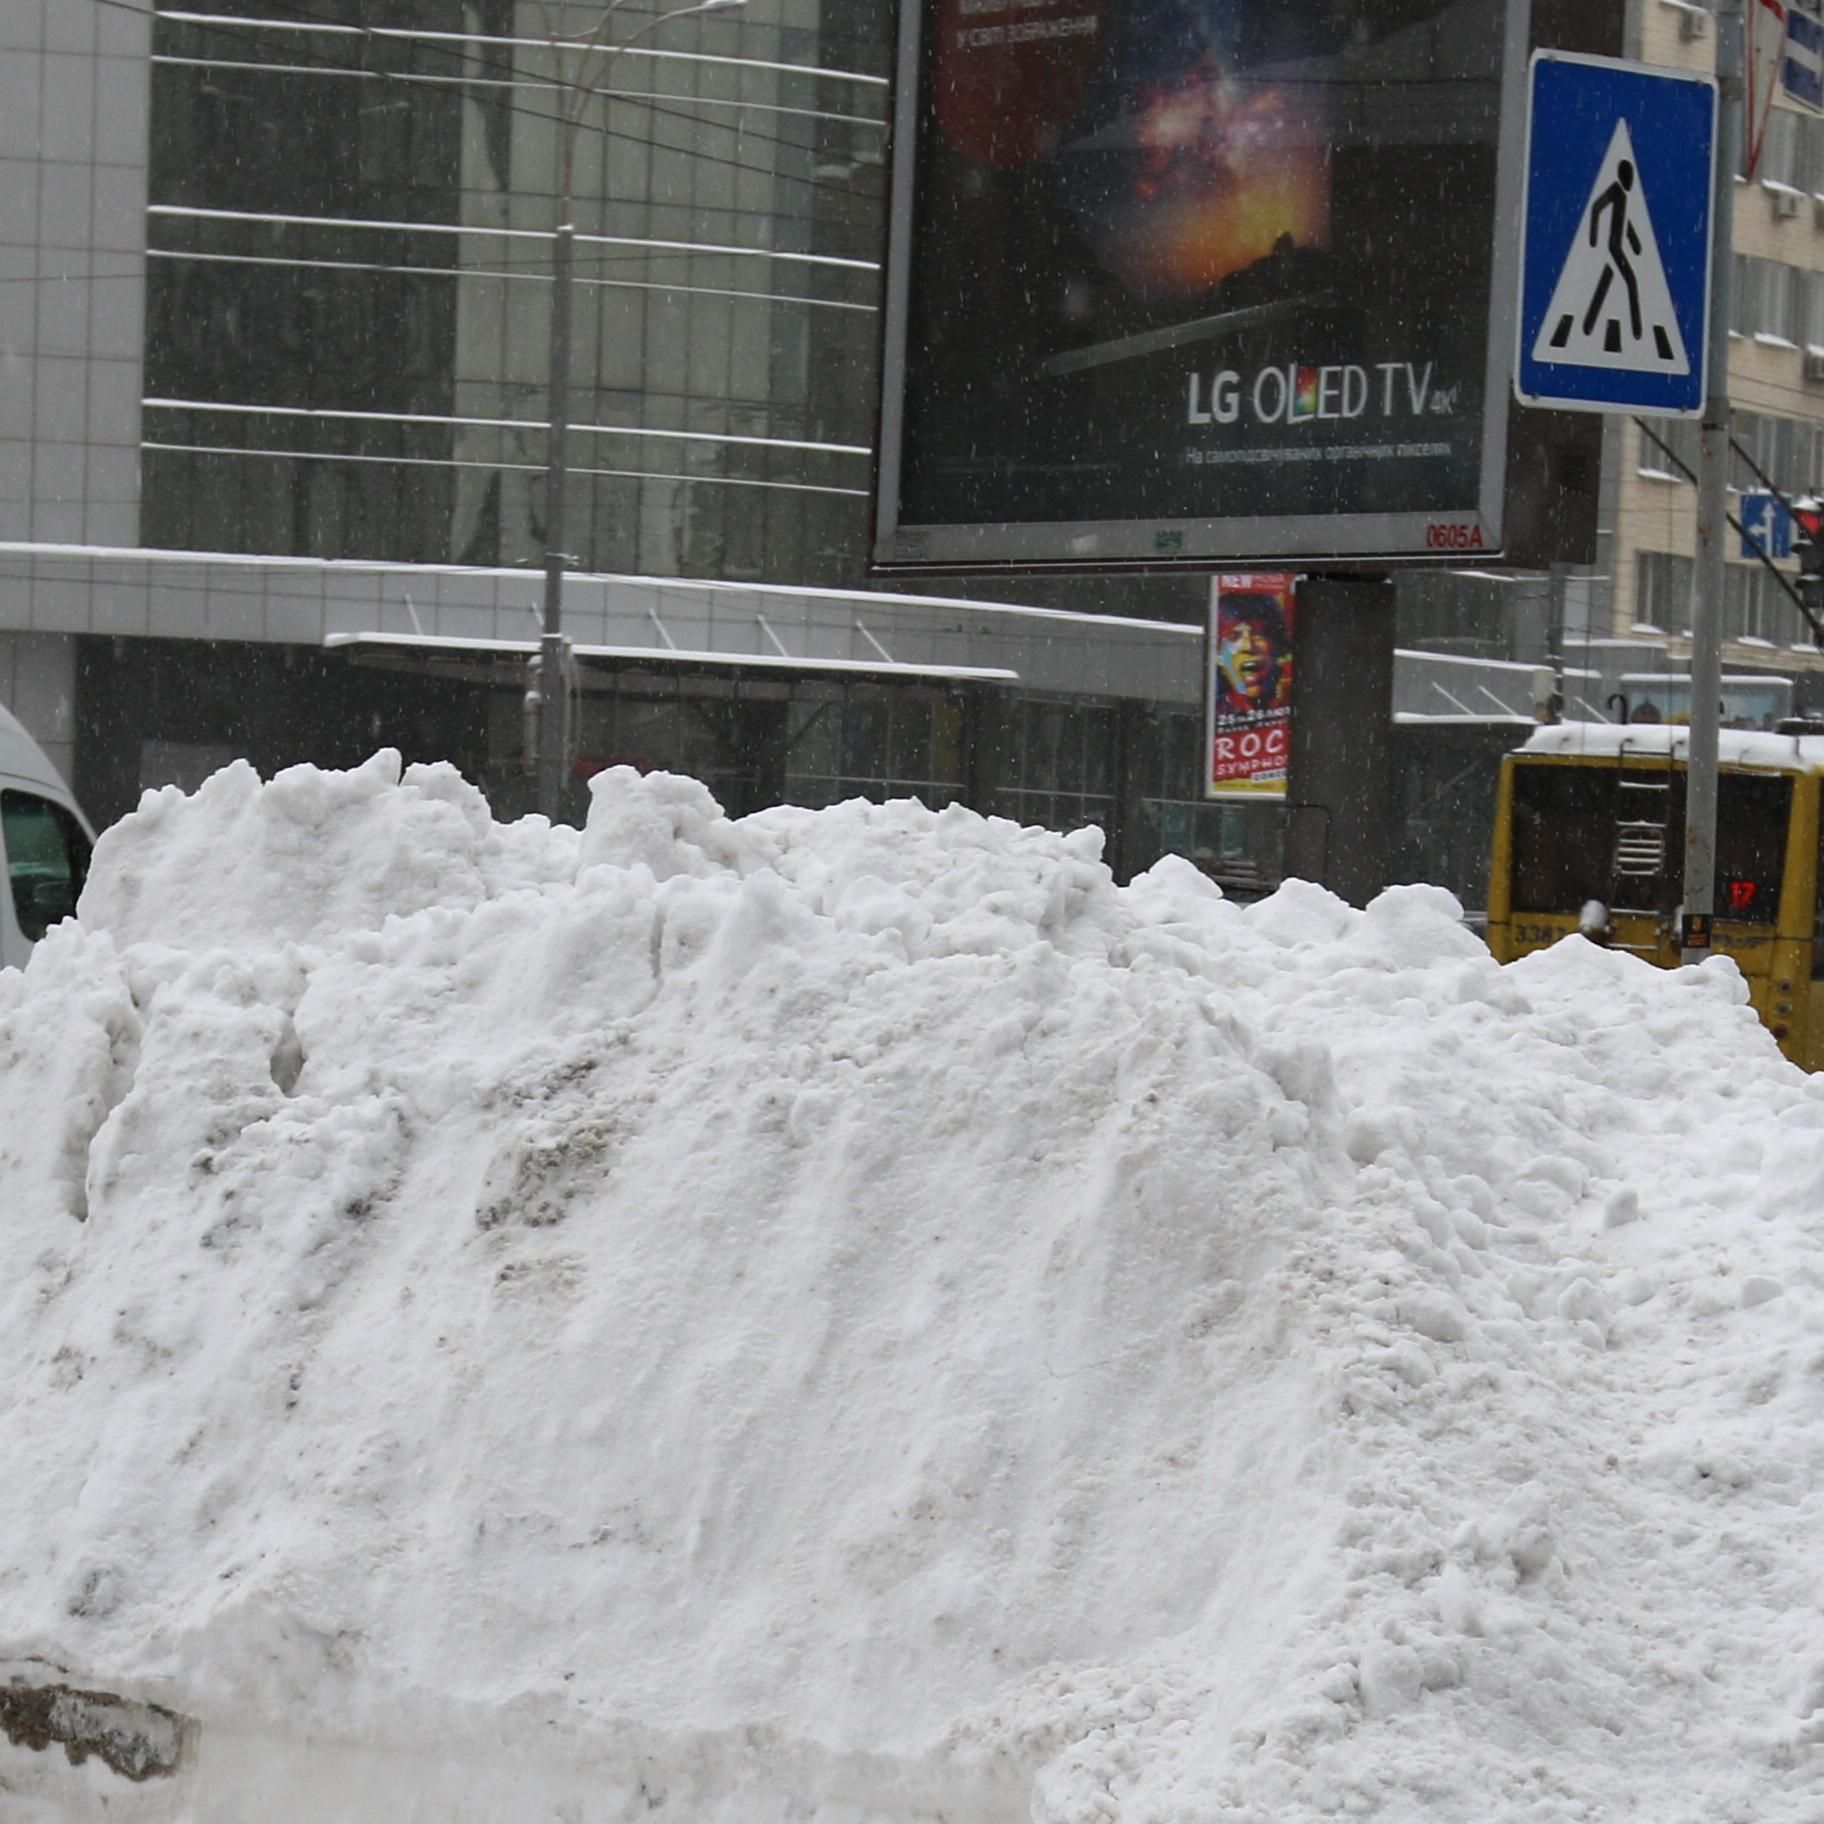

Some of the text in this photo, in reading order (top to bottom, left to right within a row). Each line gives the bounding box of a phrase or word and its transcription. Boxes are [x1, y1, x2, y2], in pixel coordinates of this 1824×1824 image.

[1189, 371, 1240, 424] LG
[1253, 362, 1368, 425] OLED
[1377, 362, 1433, 416] TV
[1186, 448, 1203, 464] На
[1427, 524, 1482, 547] 0605A
[1216, 754, 1288, 776] SYMPHO
[1729, 880, 1758, 910] 17
